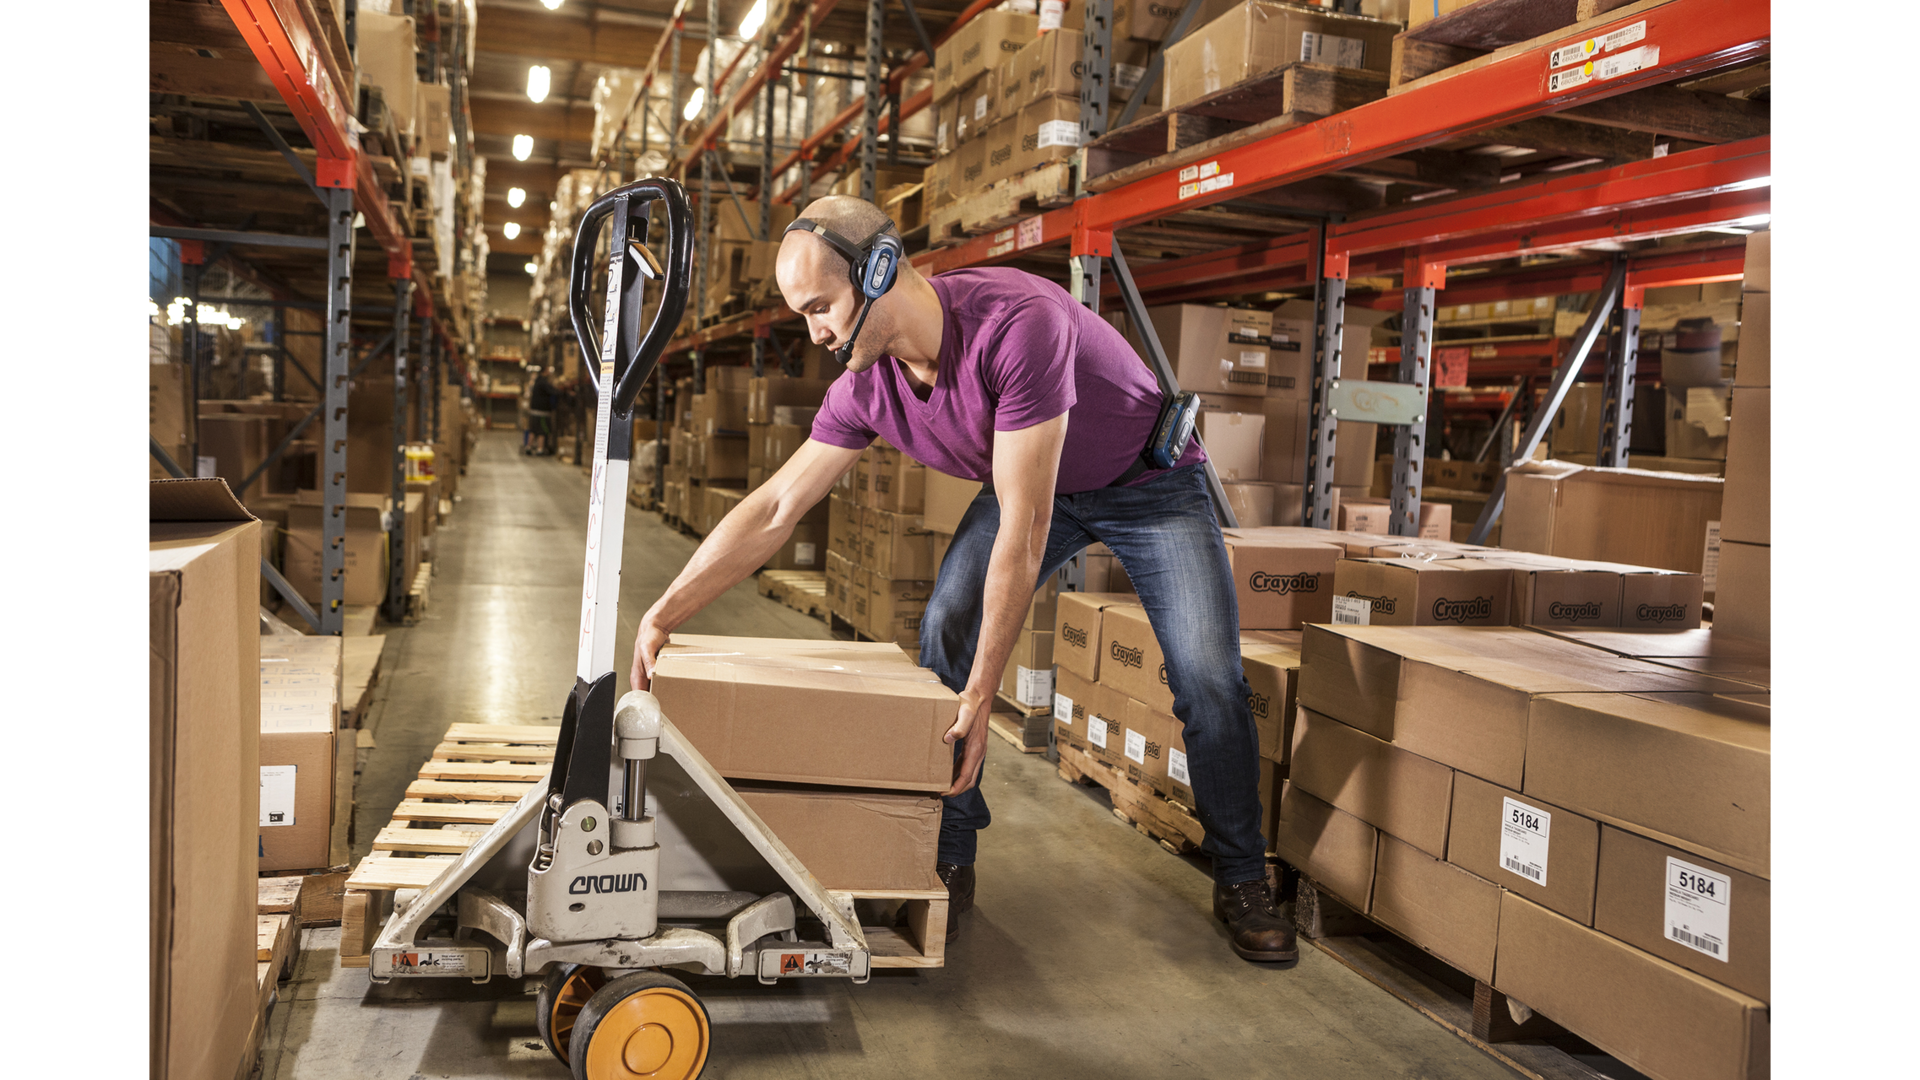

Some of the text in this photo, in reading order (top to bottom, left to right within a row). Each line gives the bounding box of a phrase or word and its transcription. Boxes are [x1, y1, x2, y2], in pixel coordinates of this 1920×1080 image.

[1250, 571, 1318, 595] Crayola
[1433, 597, 1491, 623] Crayola
[1549, 602, 1601, 622] Crayola
[1637, 604, 1685, 623] Crayola
[1062, 622, 1087, 648] Crayola
[1111, 641, 1143, 669] Crayola
[1512, 809, 1539, 831] 5184
[569, 873, 647, 895] CROWN
[1679, 871, 1715, 897] 5184
